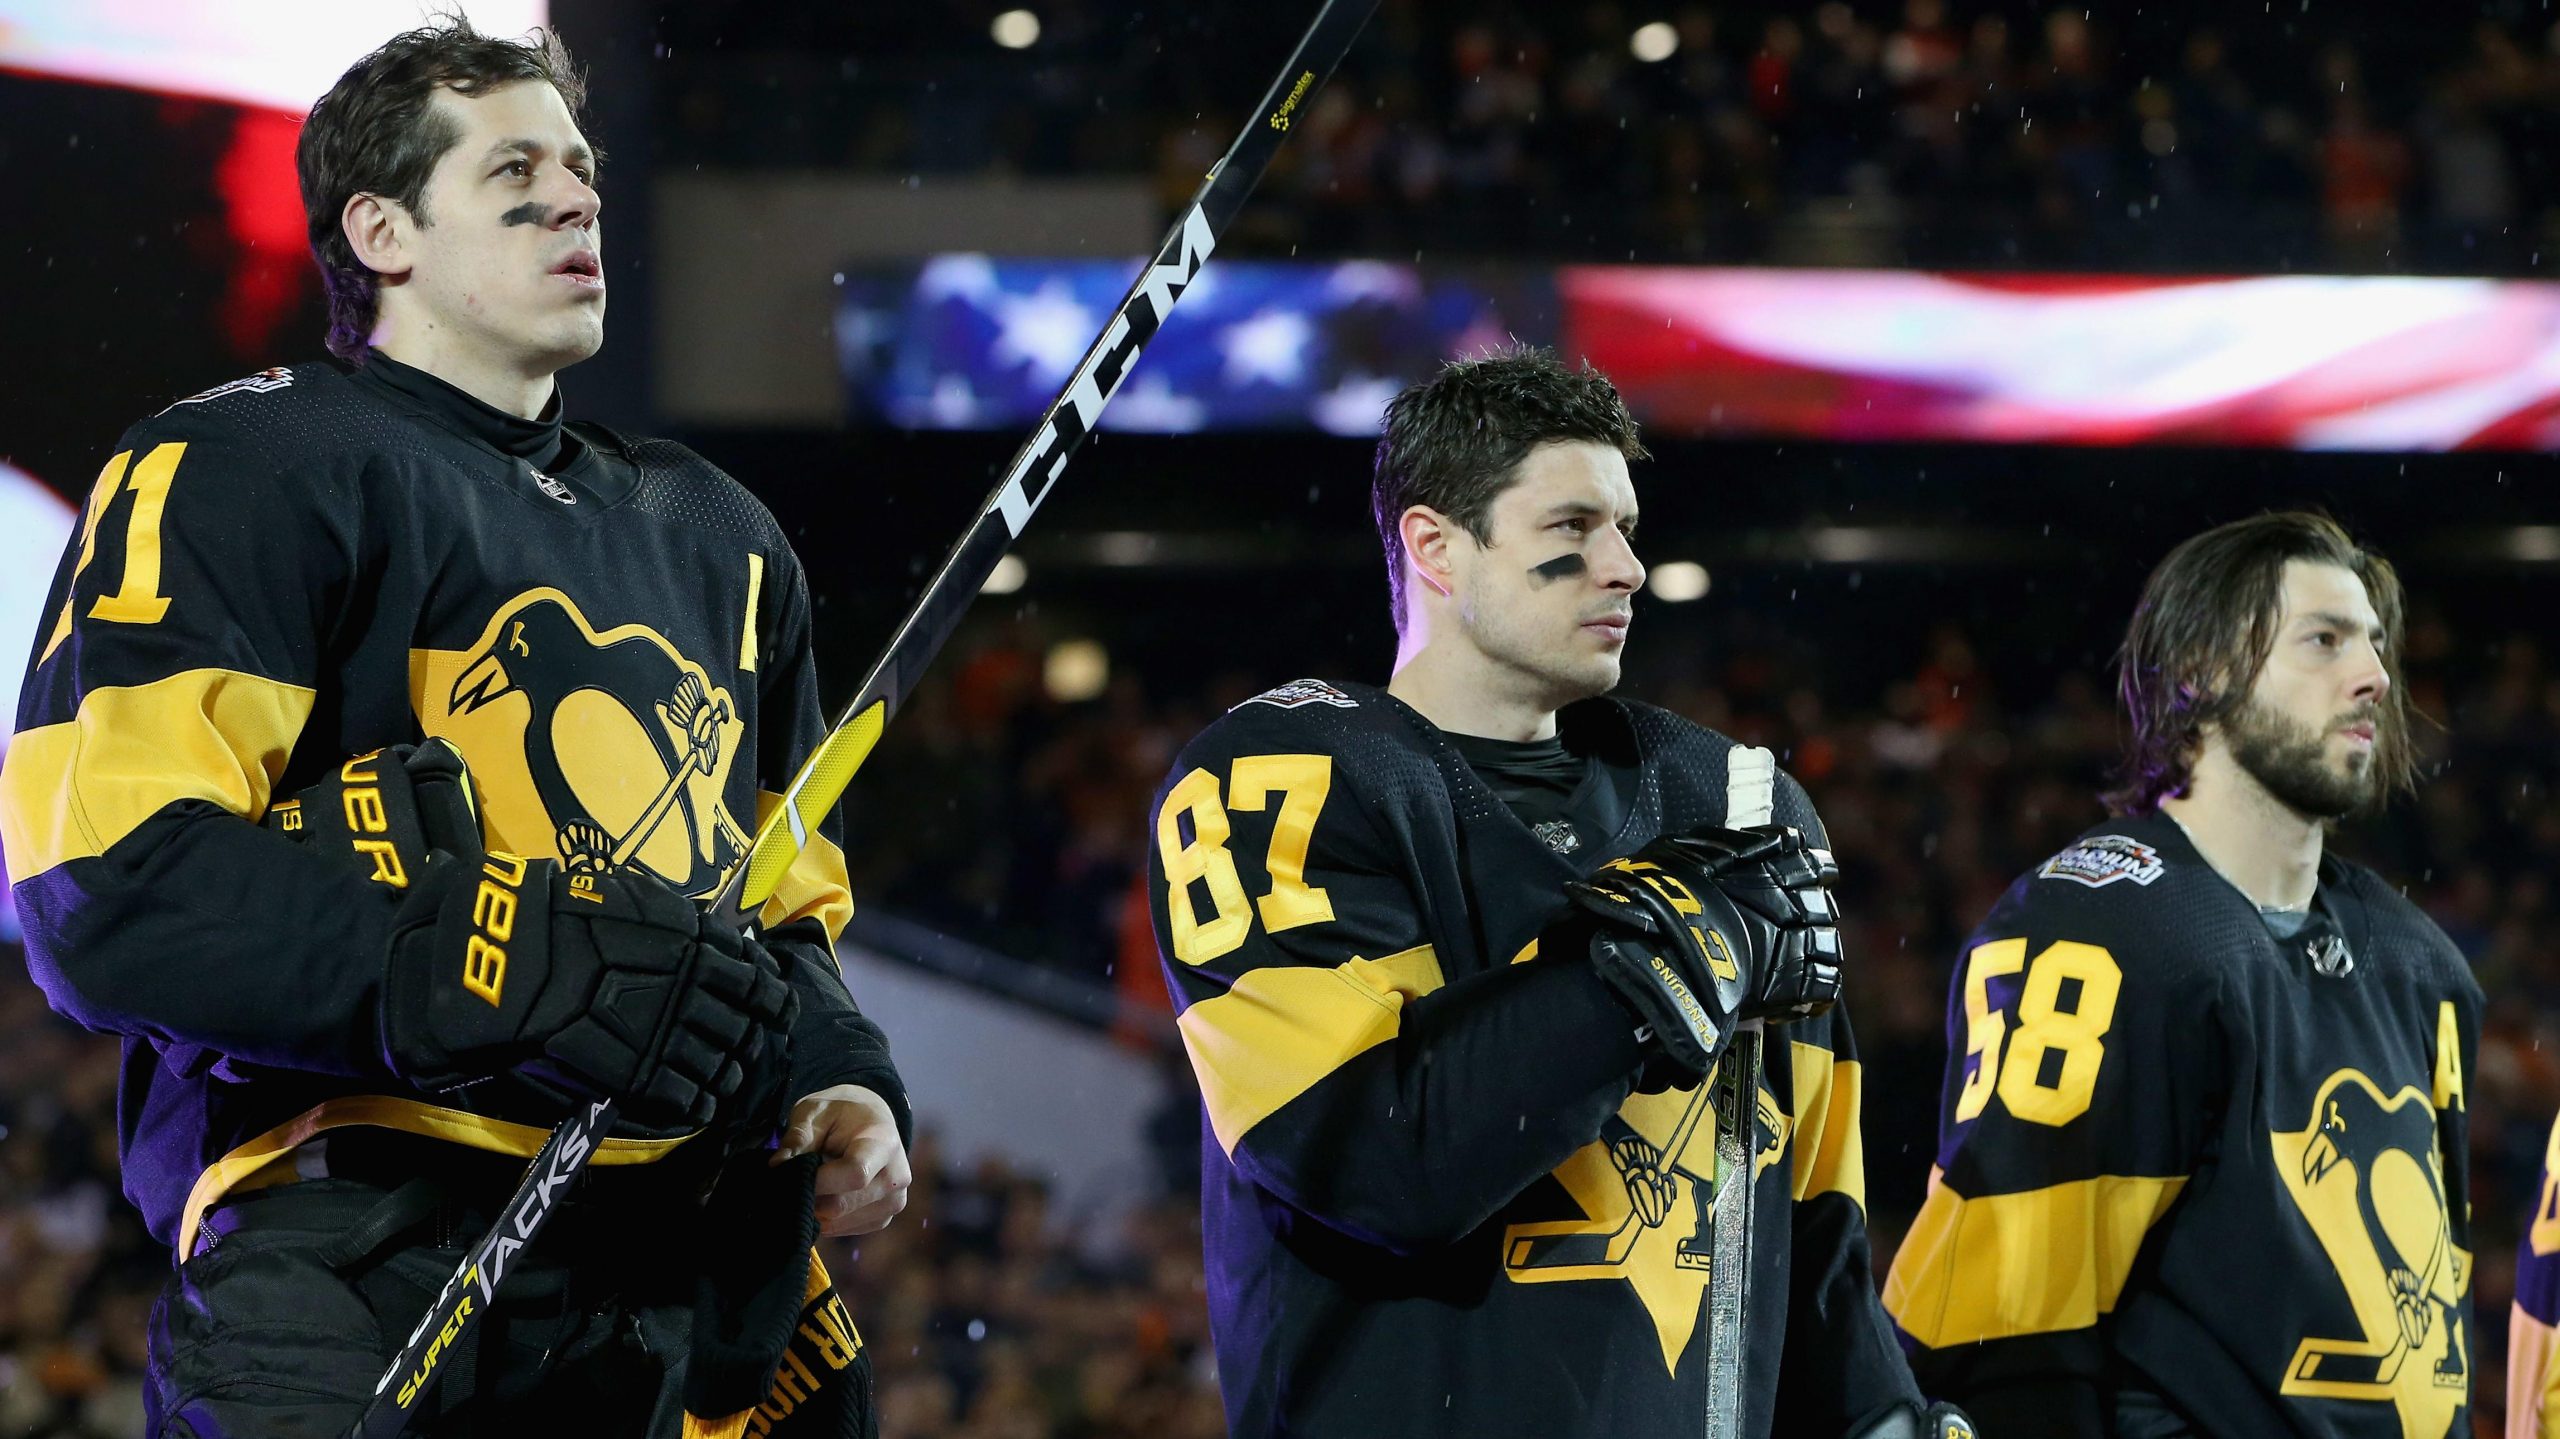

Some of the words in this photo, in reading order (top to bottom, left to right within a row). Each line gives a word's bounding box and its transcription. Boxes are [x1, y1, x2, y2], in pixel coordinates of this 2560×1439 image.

[1279, 70, 1315, 117] sigmatex
[987, 202, 1216, 540] CCM
[37, 441, 188, 669] 71
[341, 748, 409, 888] UER
[1157, 754, 1336, 965] 87
[1548, 828, 1569, 848] NHL
[463, 850, 528, 1008] BAU
[1650, 956, 1717, 1046] PENGUINS
[1955, 937, 2123, 1127] 58
[2432, 1000, 2465, 1112] A
[375, 1255, 468, 1396] CCM
[396, 1295, 474, 1409] SUPER
[463, 1122, 590, 1307] TACKS
